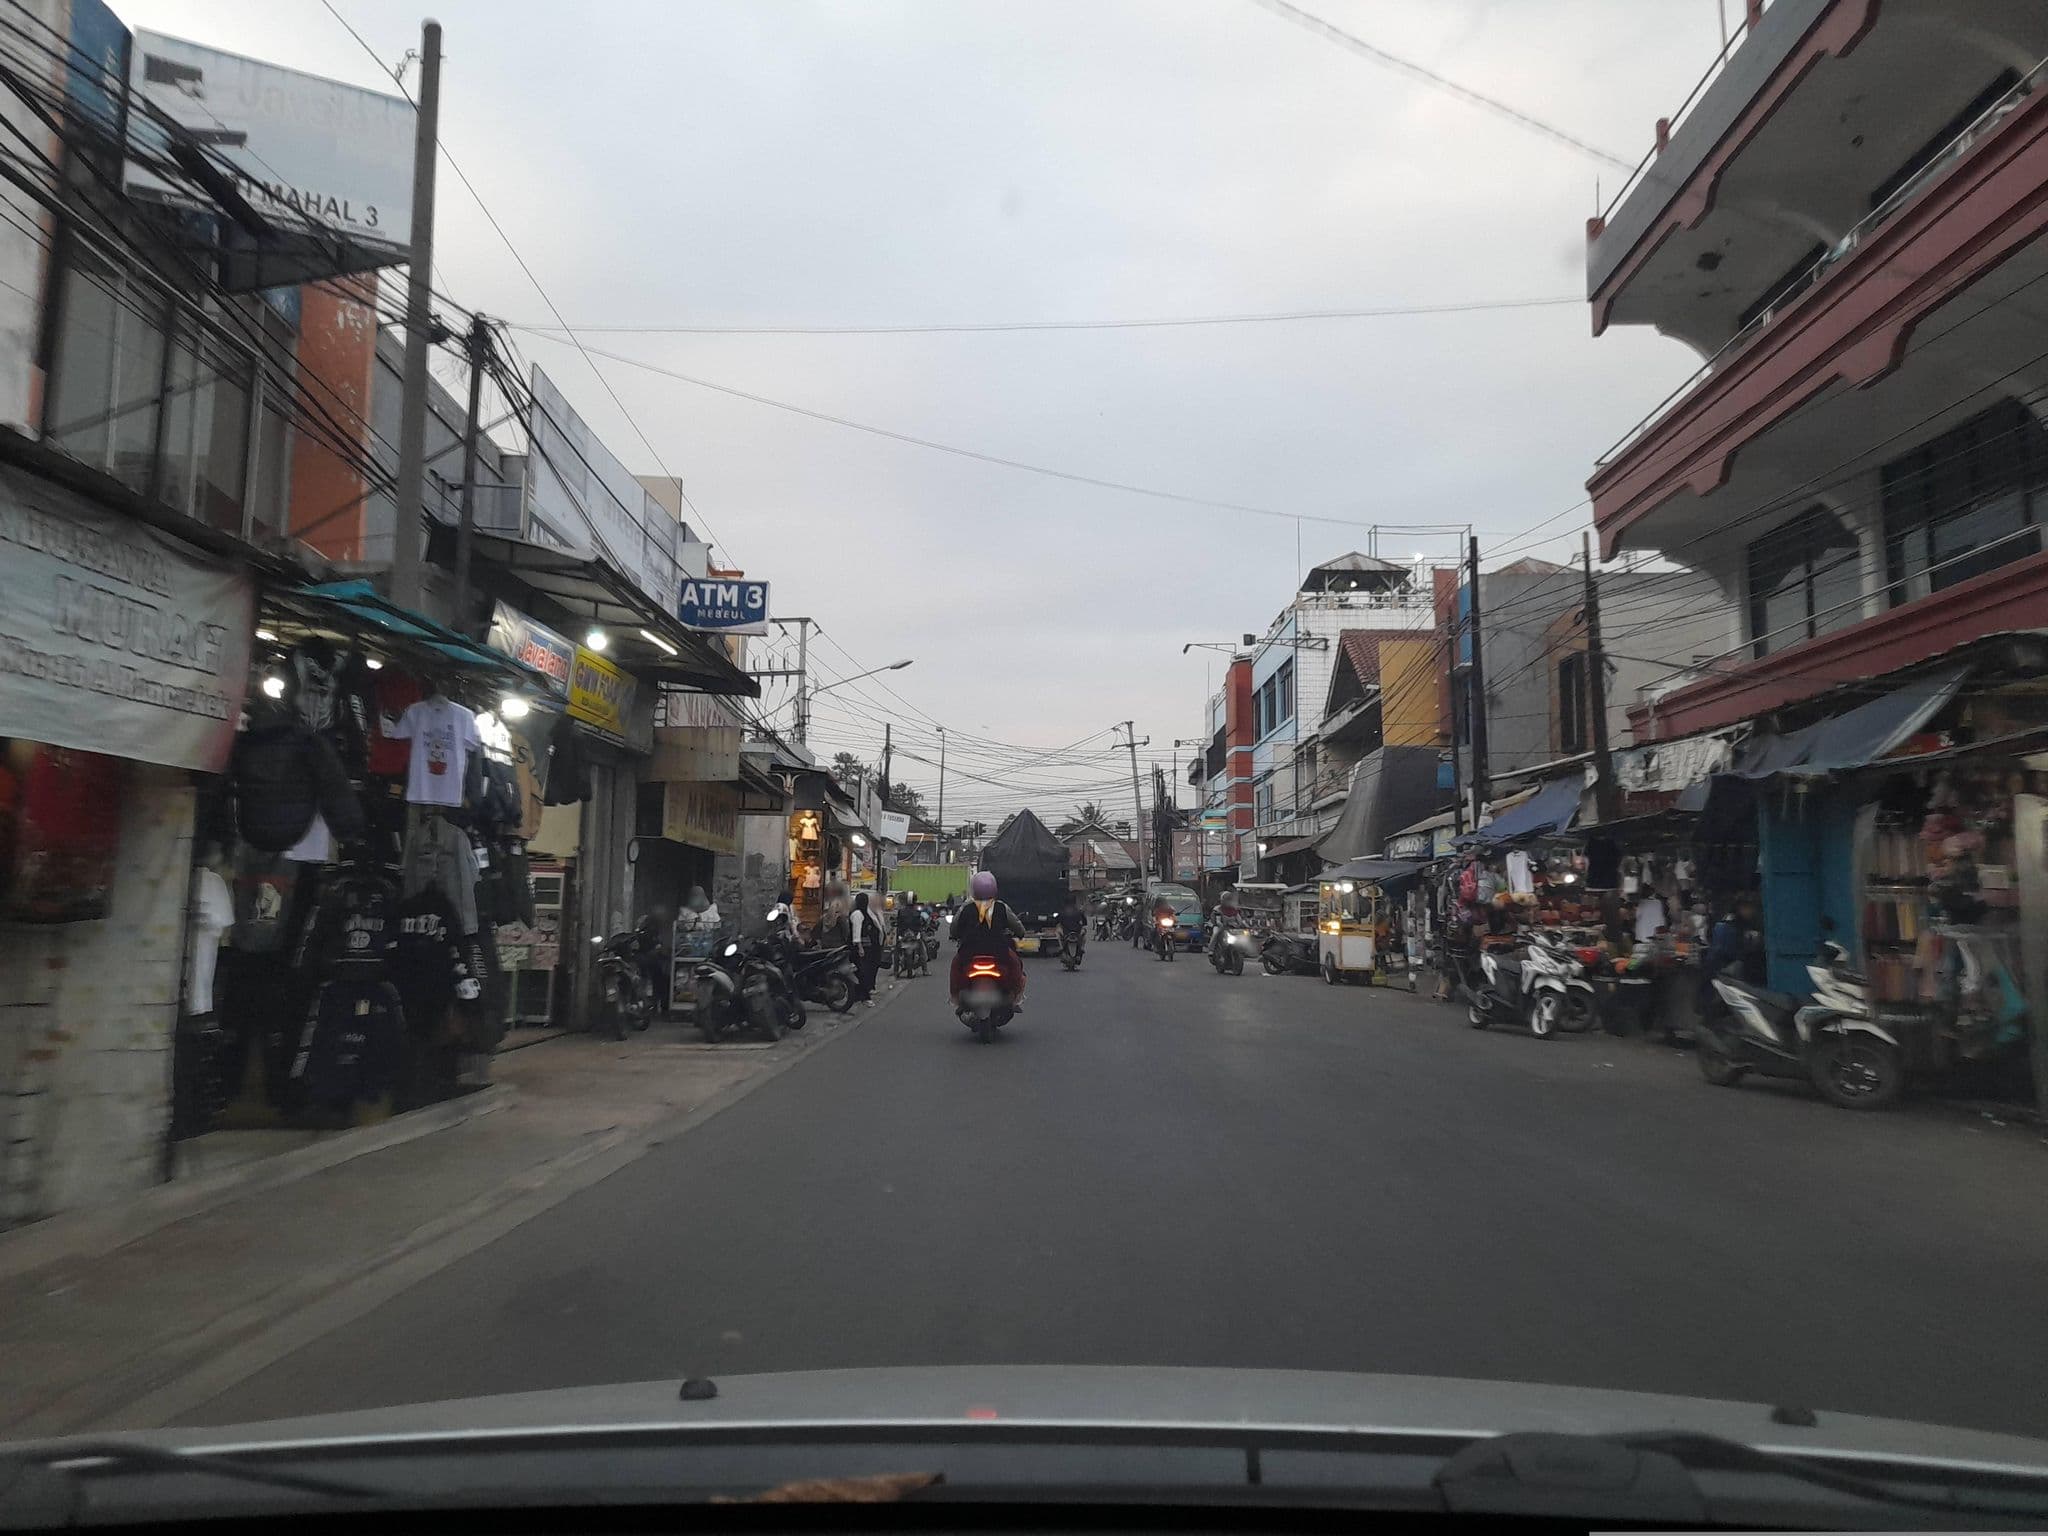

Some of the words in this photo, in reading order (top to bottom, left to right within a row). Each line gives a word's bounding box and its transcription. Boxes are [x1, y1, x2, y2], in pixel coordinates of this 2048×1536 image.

[263, 181, 357, 222] MAHAL
[366, 205, 379, 227] 3
[681, 582, 739, 608] ATM
[747, 585, 763, 609] 3
[697, 607, 746, 620] MEBEUL
